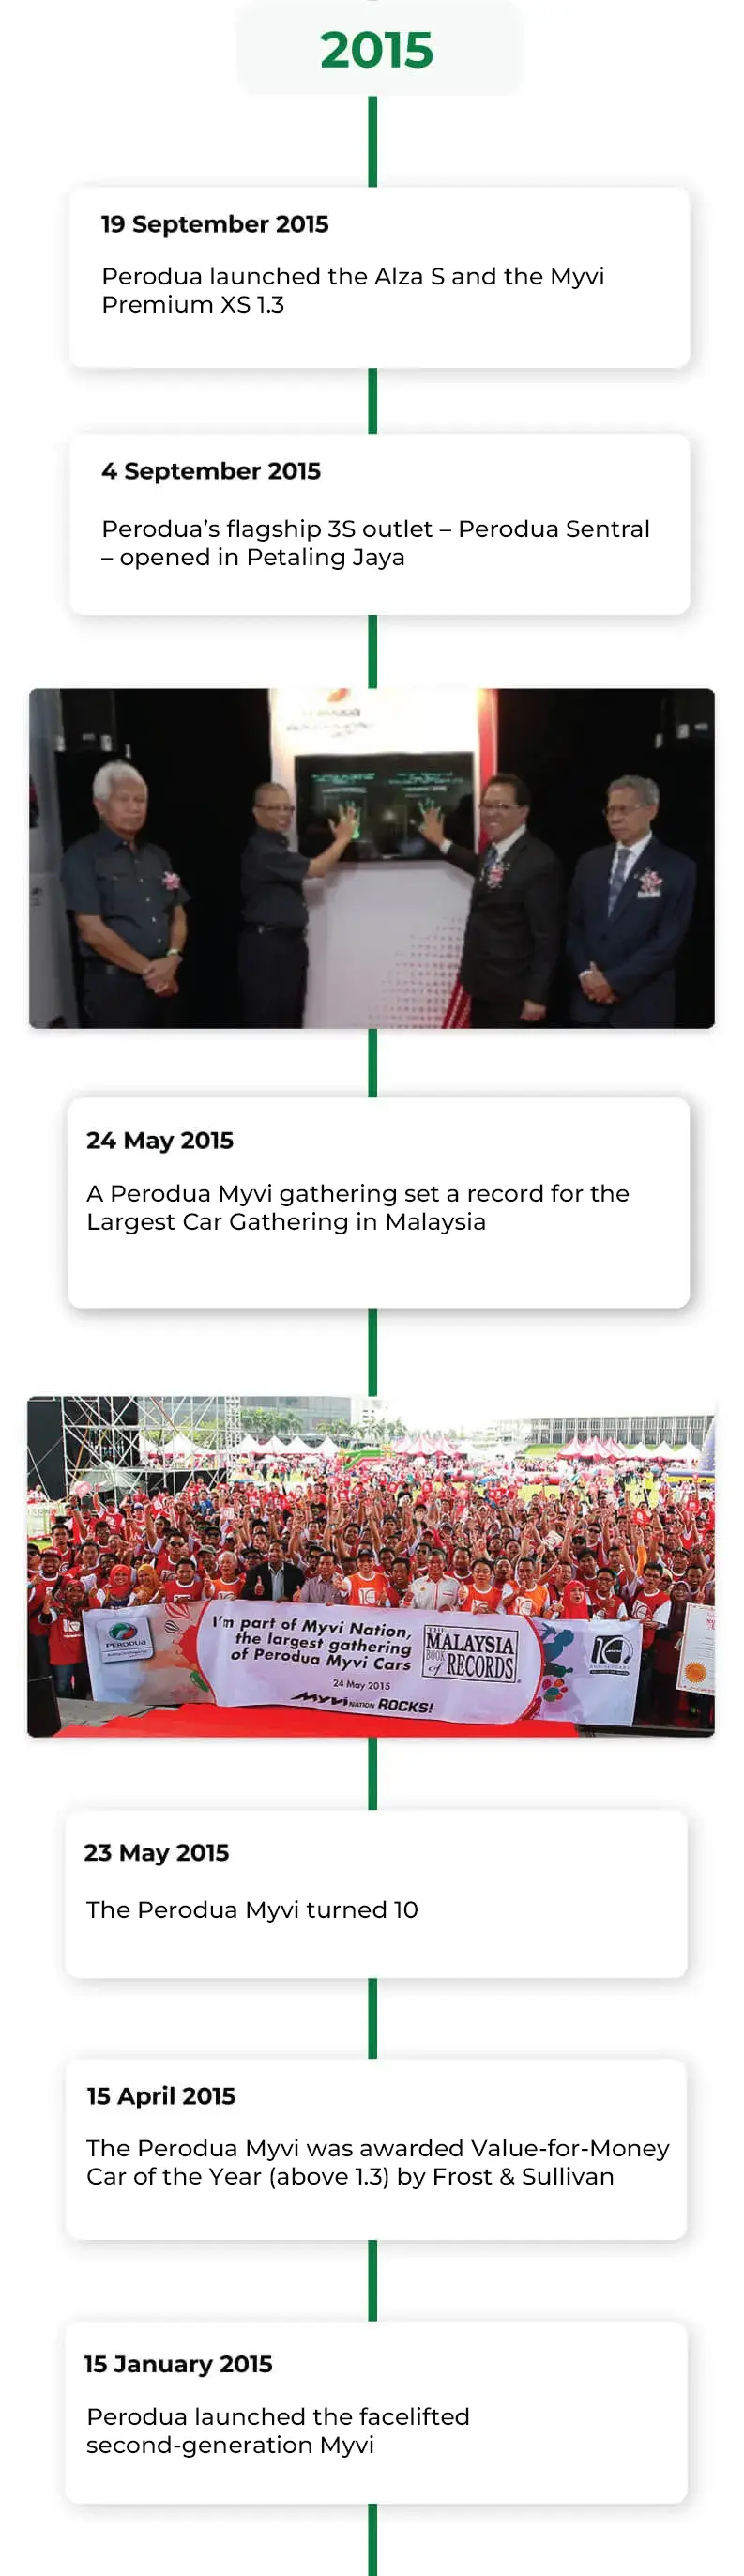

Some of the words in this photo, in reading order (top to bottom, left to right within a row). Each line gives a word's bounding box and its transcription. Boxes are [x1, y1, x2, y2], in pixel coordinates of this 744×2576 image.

[212, 1616, 234, 1628] I'm
[240, 1618, 276, 1632] part
[281, 1618, 297, 1631] of
[301, 1619, 345, 1636] Myvi
[349, 1622, 412, 1641] Nation,
[235, 1631, 262, 1645] the
[267, 1632, 324, 1650] largest
[328, 1639, 412, 1659] gathering
[426, 1633, 514, 1655] MALAYSIA
[231, 1647, 249, 1661] of
[254, 1648, 320, 1665] Perodua
[326, 1654, 369, 1671] Myvi
[373, 1657, 412, 1671] Cars
[426, 1649, 445, 1662] BOOK
[447, 1653, 514, 1679] RECORDS
[428, 1662, 443, 1676] of
[333, 1679, 344, 1688] 24
[346, 1680, 366, 1691] May
[368, 1681, 390, 1691] 2015
[348, 1701, 375, 1710] NATION
[378, 1698, 433, 1713] ROCKS!
